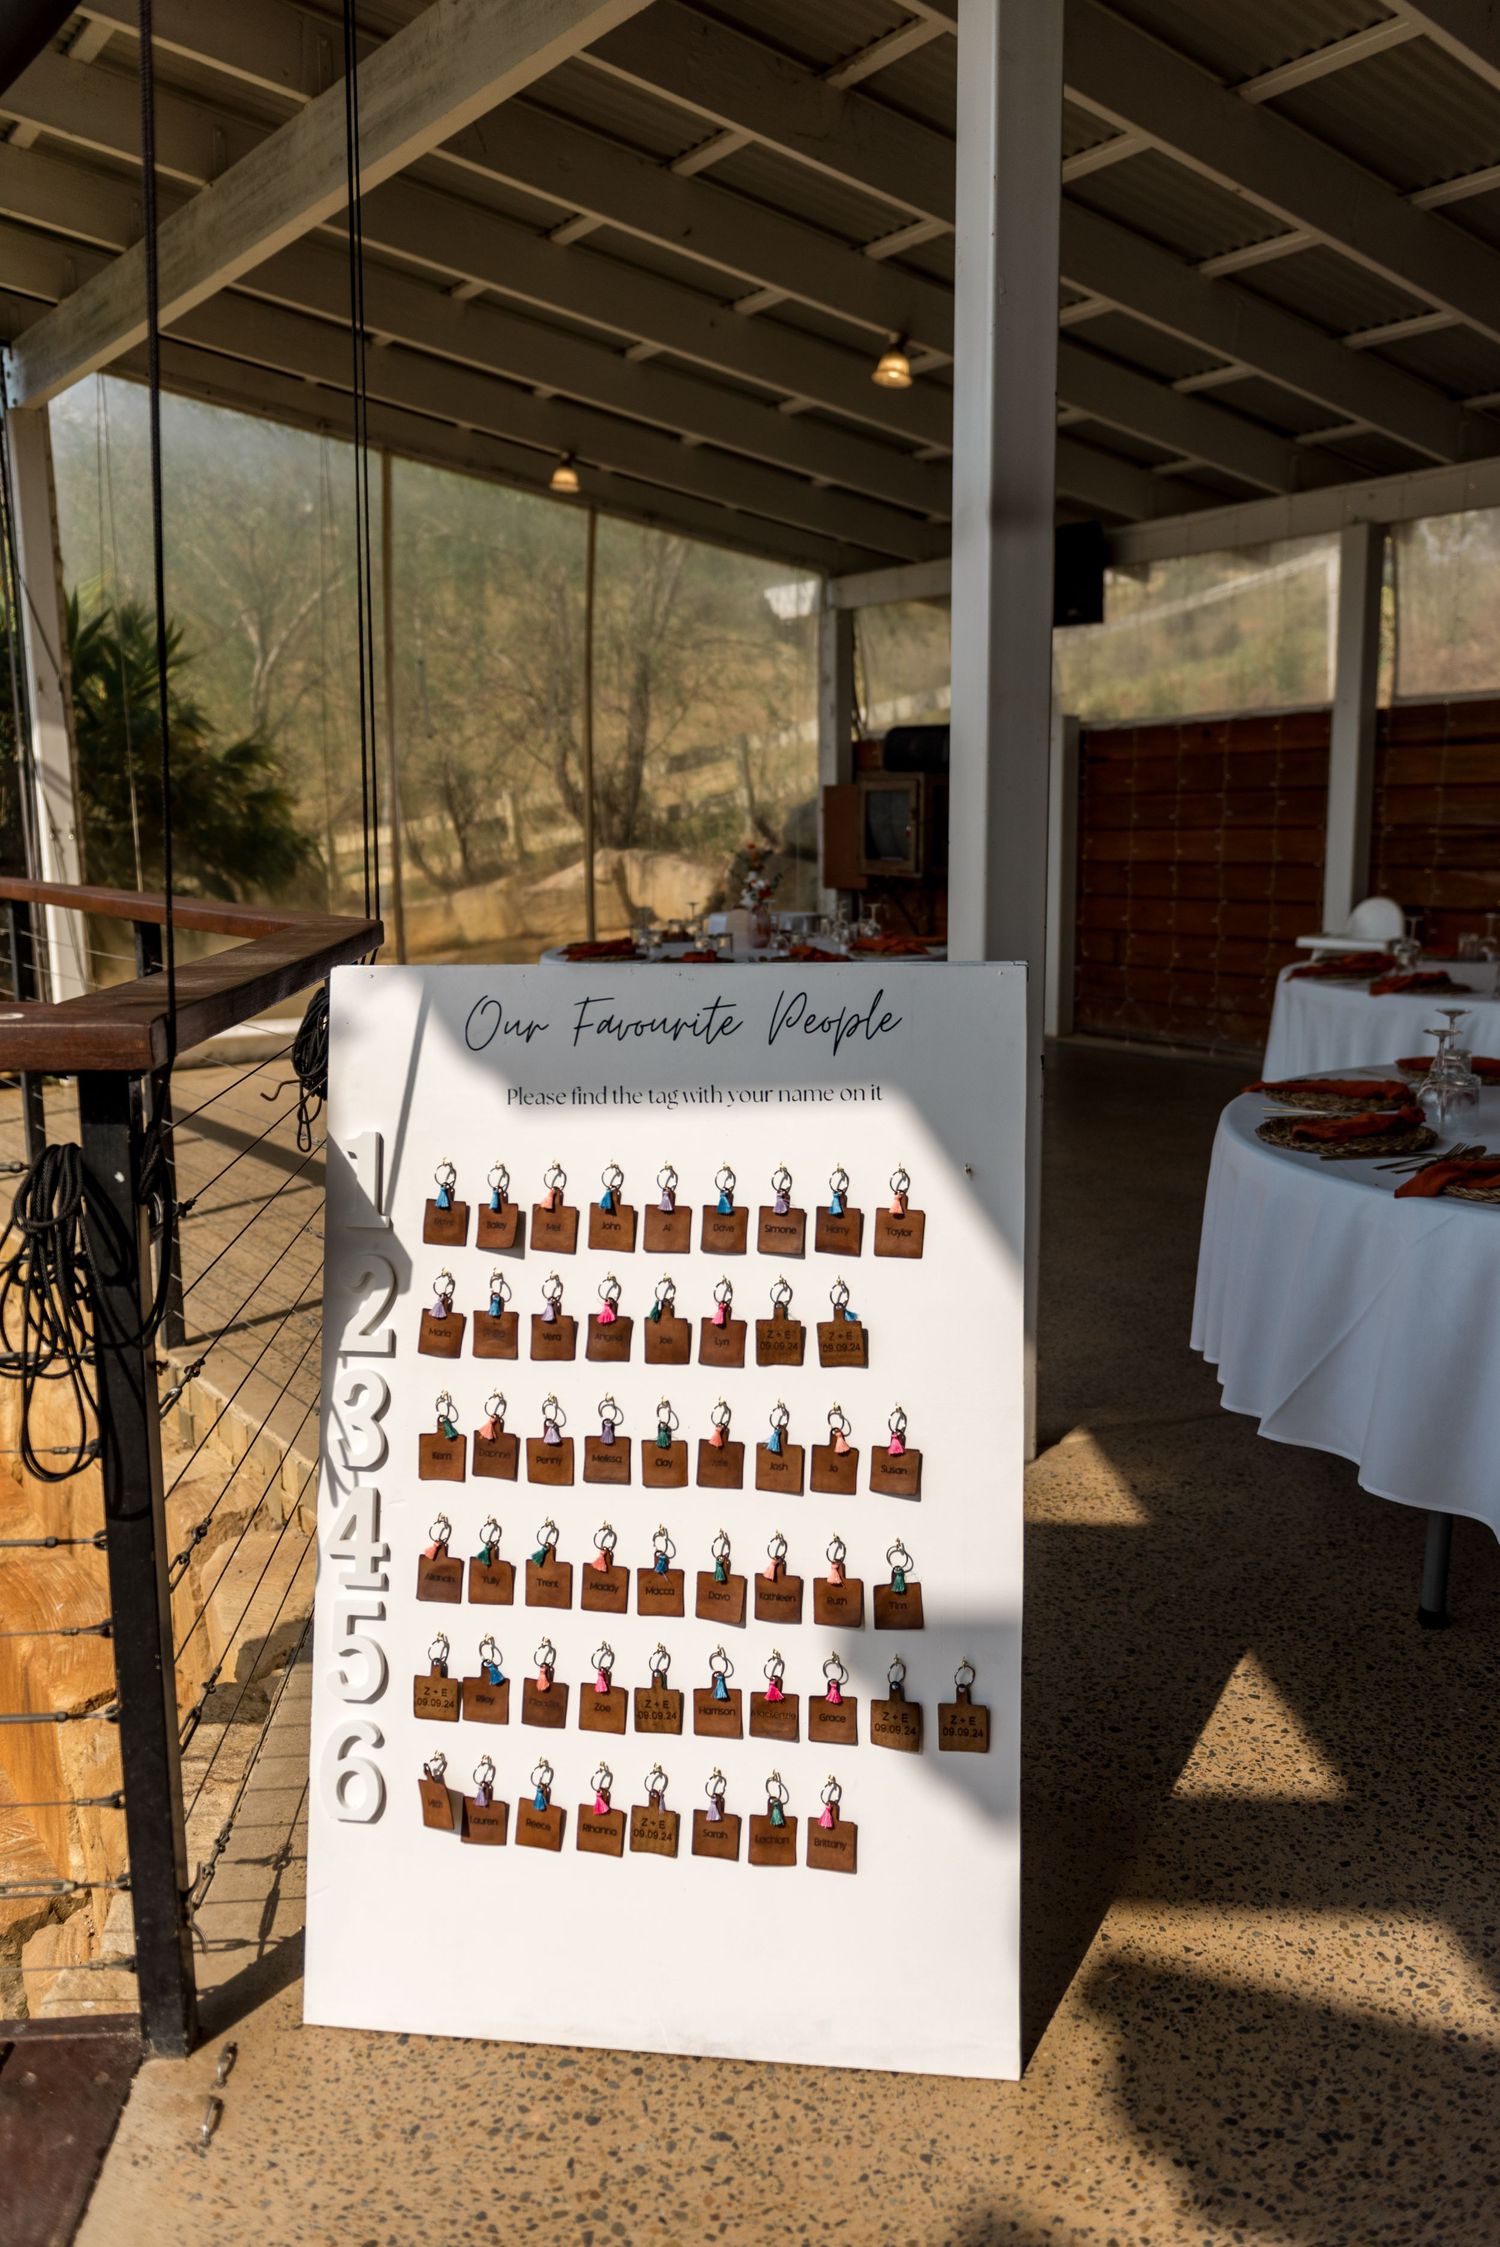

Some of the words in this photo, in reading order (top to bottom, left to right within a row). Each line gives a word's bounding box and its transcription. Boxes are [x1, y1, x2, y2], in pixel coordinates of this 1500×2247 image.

[465, 995, 549, 1051] Our
[573, 995, 743, 1047] Favourite
[768, 989, 903, 1056] People
[507, 1087, 566, 1105] Please
[572, 1086, 607, 1104] find
[613, 1085, 642, 1104] the
[649, 1089, 678, 1110] tag
[682, 1084, 722, 1104] with
[727, 1089, 773, 1107] your
[778, 1088, 834, 1102] name
[840, 1088, 865, 1101] on
[871, 1084, 882, 1101] it
[344, 1131, 393, 1229] 1
[601, 1221, 621, 1231] John
[764, 1225, 797, 1234] Simone
[885, 1227, 913, 1238] Taylor
[338, 1254, 397, 1354] 2
[767, 1330, 775, 1339] Z
[785, 1331, 791, 1339] E
[829, 1333, 836, 1341] Z
[846, 1332, 853, 1340] E
[759, 1341, 798, 1351] 09.09.24
[822, 1344, 861, 1353] 09.09.24
[327, 1369, 389, 1470] 3
[769, 1462, 788, 1471] Josh
[323, 1487, 390, 1590] 4
[326, 1601, 389, 1703] 5
[423, 1687, 431, 1695] Z
[441, 1689, 448, 1697] E
[417, 1698, 455, 1709] 09.09.24
[594, 1703, 611, 1713] Zoe
[644, 1700, 652, 1709] Z
[663, 1700, 669, 1709] E
[638, 1711, 677, 1721] 09.09.24
[819, 1713, 846, 1723] Grace
[882, 1712, 889, 1721] Z
[901, 1713, 908, 1722] E
[950, 1715, 958, 1725] Z
[969, 1716, 976, 1726] E
[875, 1724, 916, 1735] 09.09.24
[942, 1727, 983, 1738] 09.09.24
[320, 1719, 386, 1822] 6
[641, 1818, 649, 1827] Z
[659, 1820, 666, 1829] E
[634, 1828, 672, 1841] 09.09.24
[703, 1830, 728, 1840] Sarah
[814, 1837, 848, 1851] Brittany
